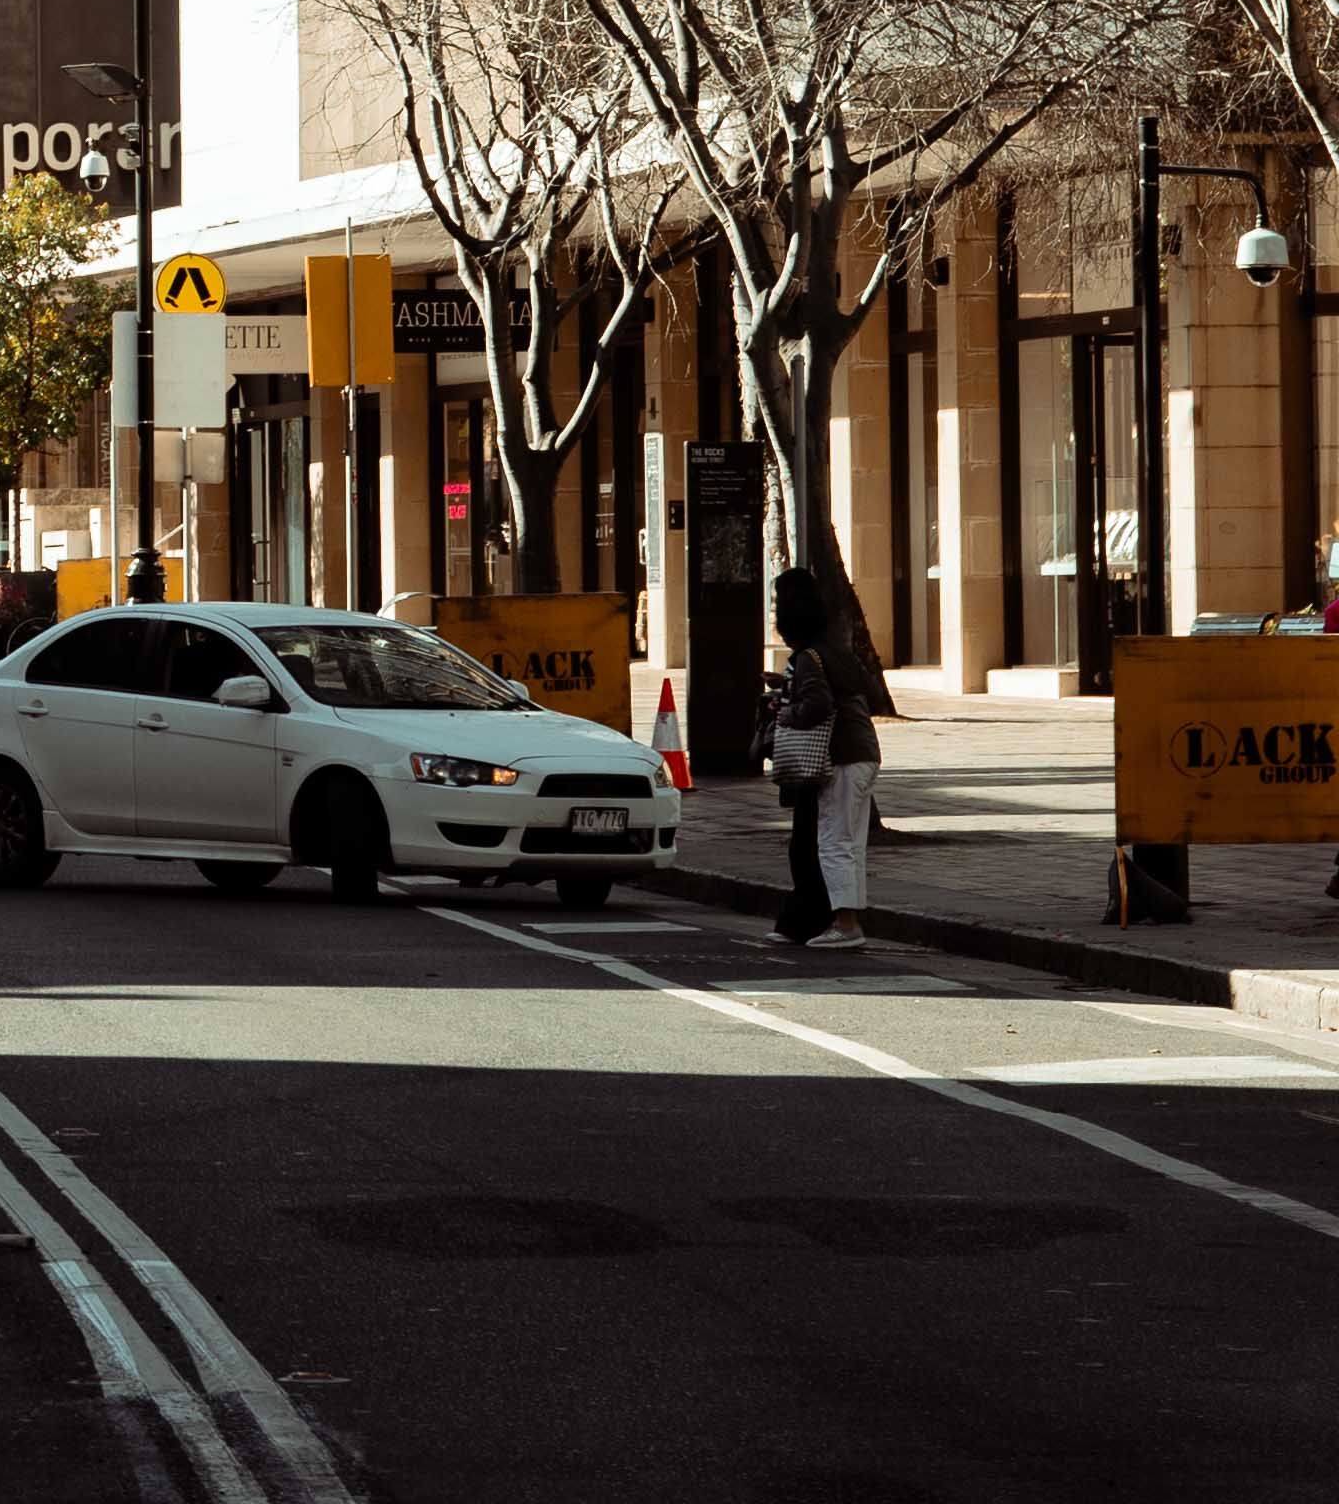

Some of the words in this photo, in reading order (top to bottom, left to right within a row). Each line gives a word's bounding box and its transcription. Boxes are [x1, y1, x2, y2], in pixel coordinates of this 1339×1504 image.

[225, 325, 281, 349] ETTE
[543, 679, 596, 691] GROUP
[1260, 766, 1335, 784] GROUP
